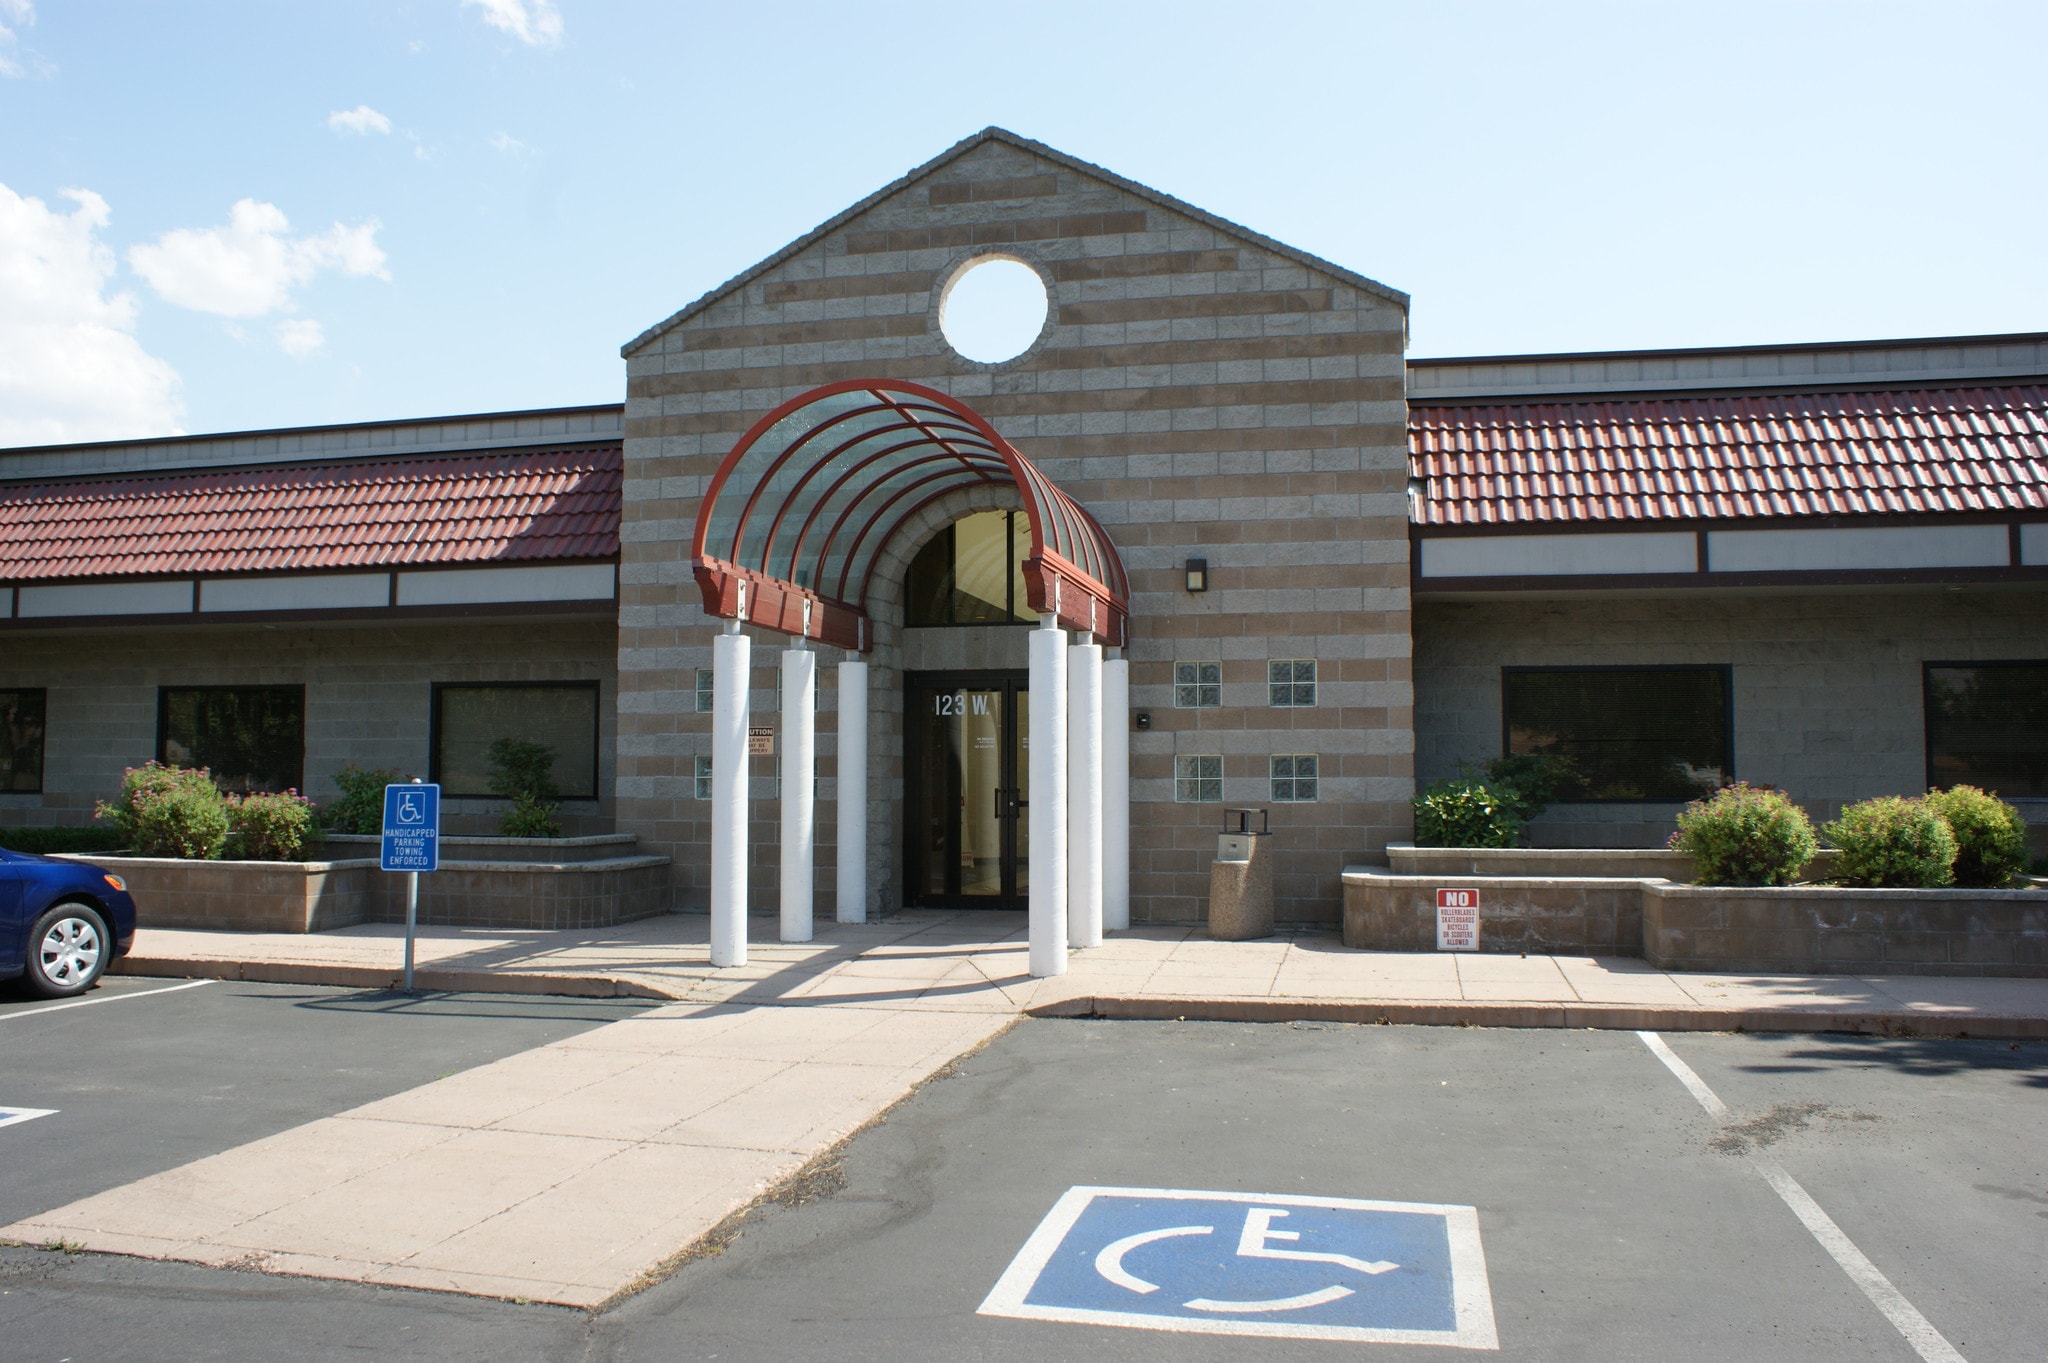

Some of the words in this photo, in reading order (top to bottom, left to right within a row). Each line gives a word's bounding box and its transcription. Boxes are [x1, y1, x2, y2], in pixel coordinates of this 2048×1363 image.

[936, 695, 966, 715] 123
[972, 695, 990, 715] W.
[385, 829, 435, 838] HANDICAPPED
[394, 838, 425, 847] PARKING
[395, 847, 423, 856] TOWING
[390, 856, 429, 865] ENFORCED
[1446, 892, 1469, 907] NO
